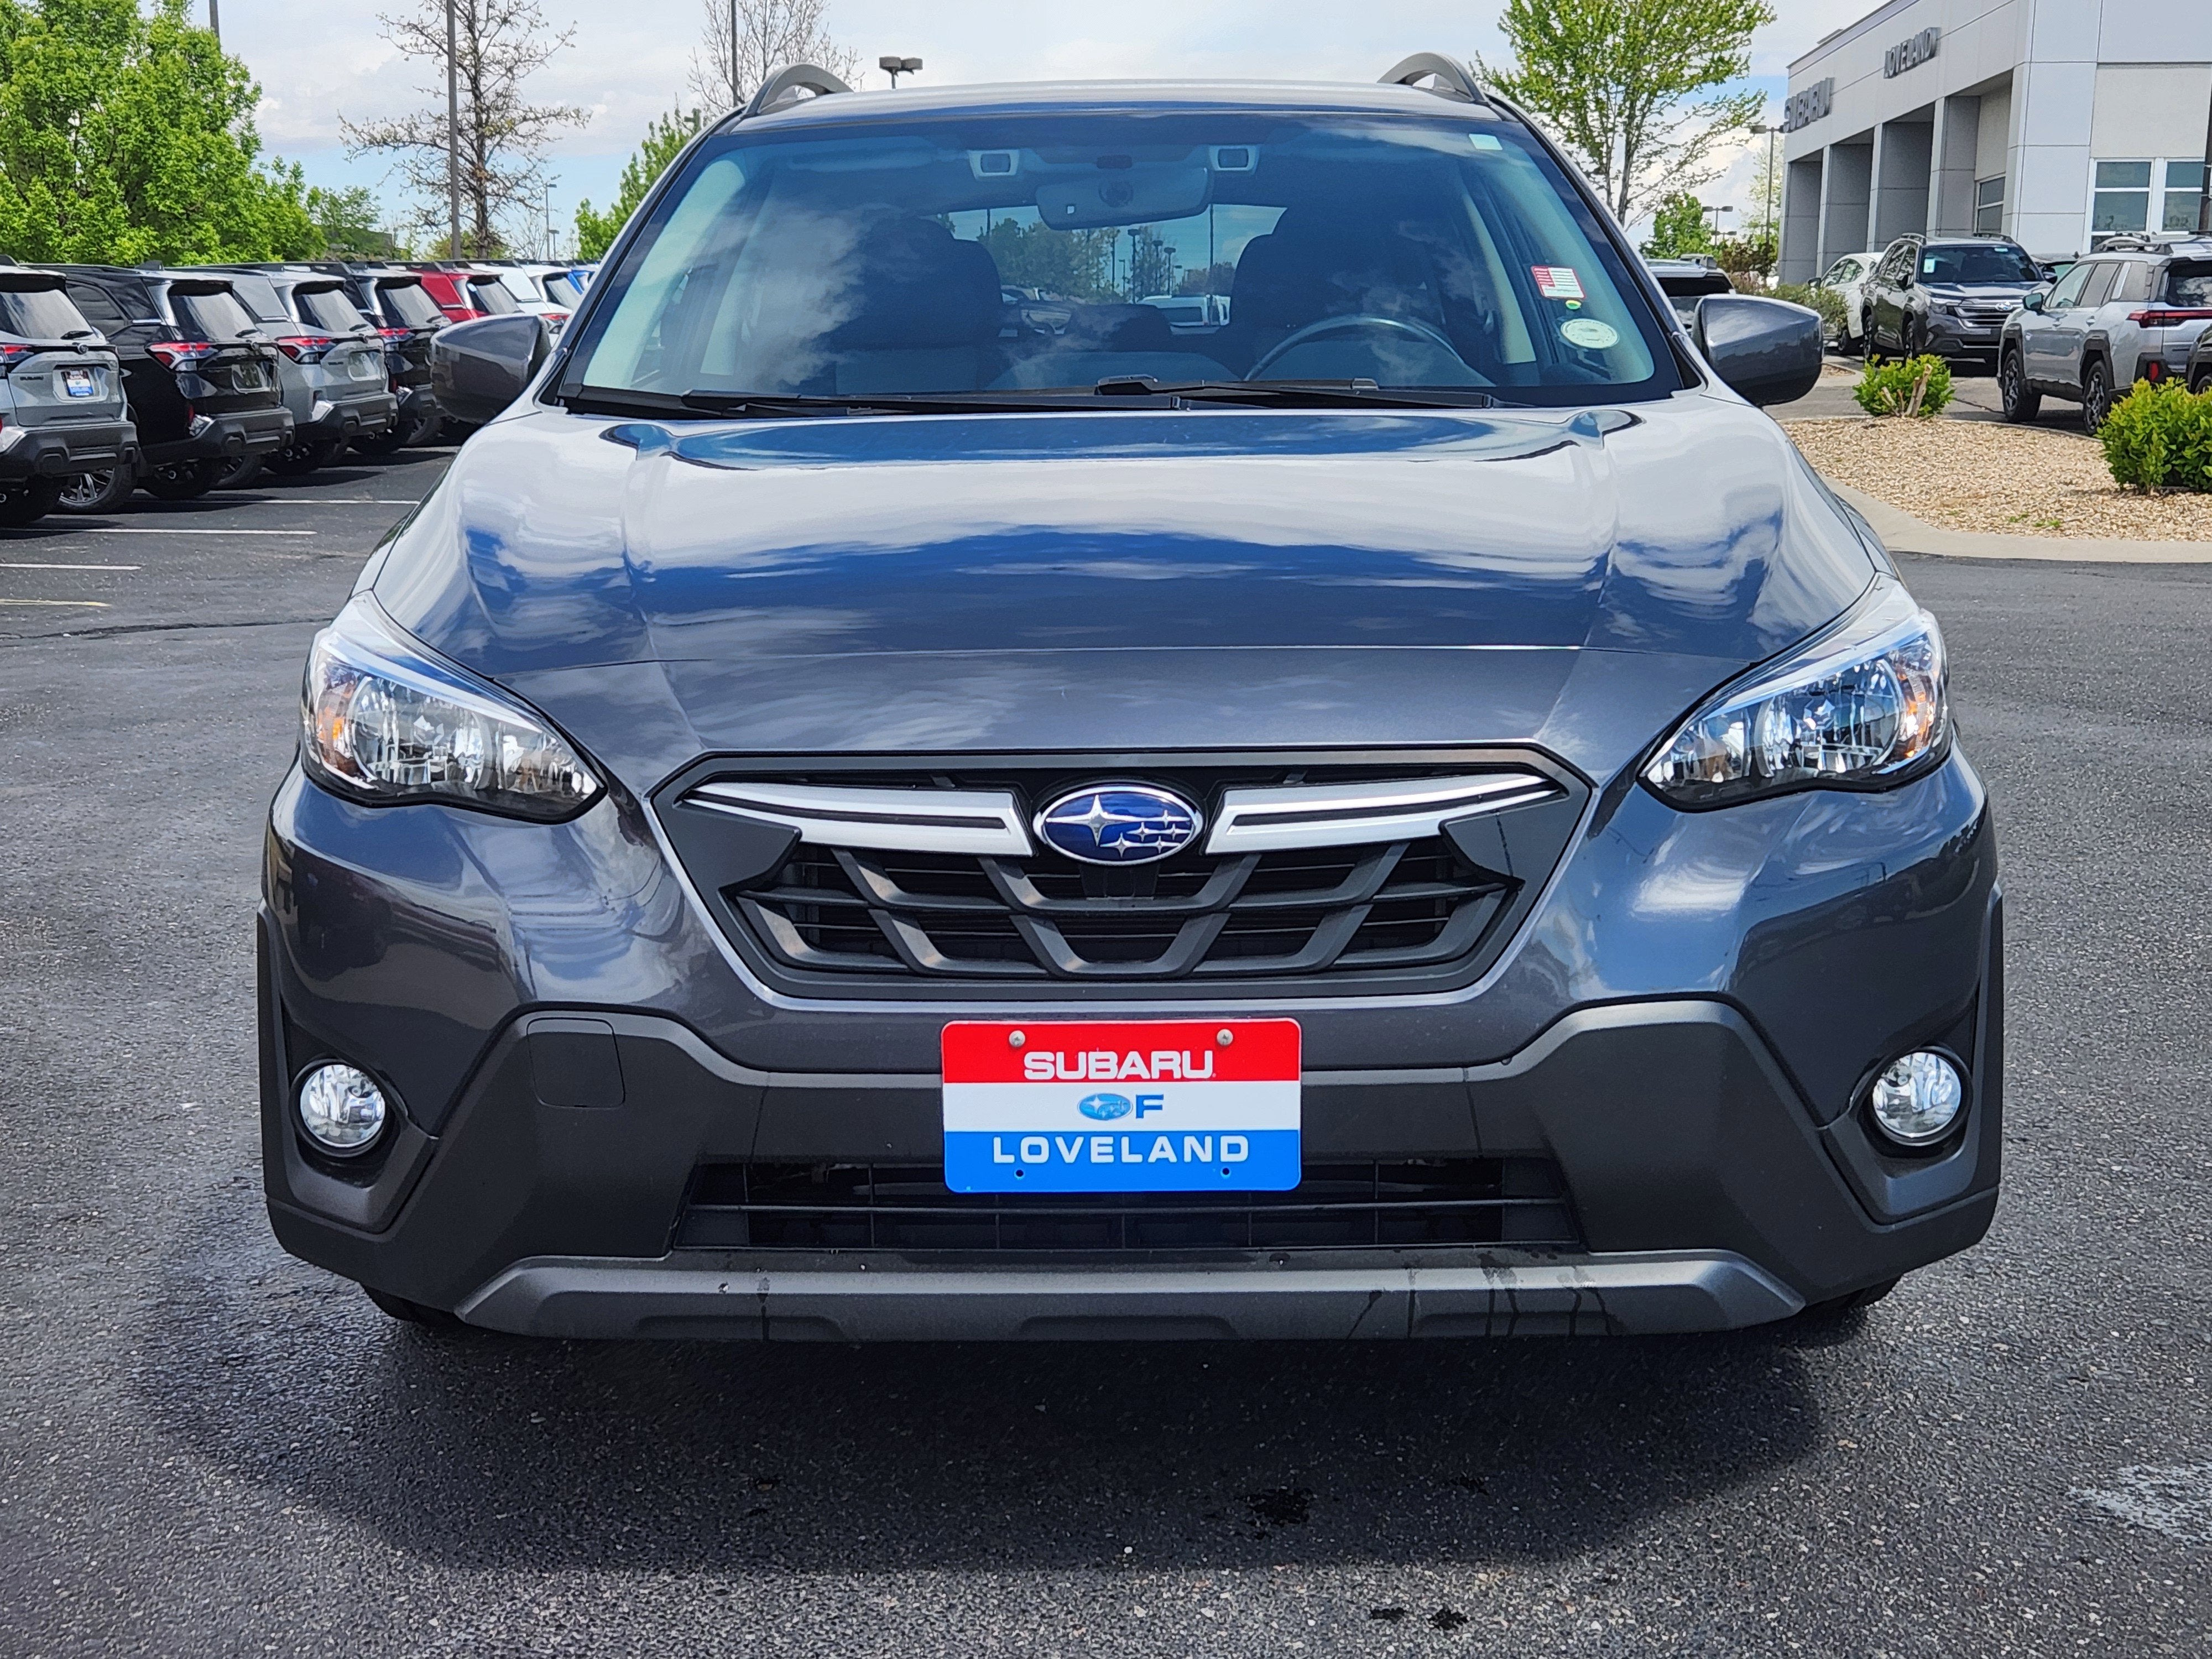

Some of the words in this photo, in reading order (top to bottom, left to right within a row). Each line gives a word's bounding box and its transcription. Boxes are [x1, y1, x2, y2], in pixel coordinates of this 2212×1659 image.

[1883, 27, 1940, 79] LOVELAND
[1783, 77, 1834, 133] SUBARU
[1024, 1050, 1214, 1080] SUBARU
[993, 1135, 1249, 1164] LOVELAND
